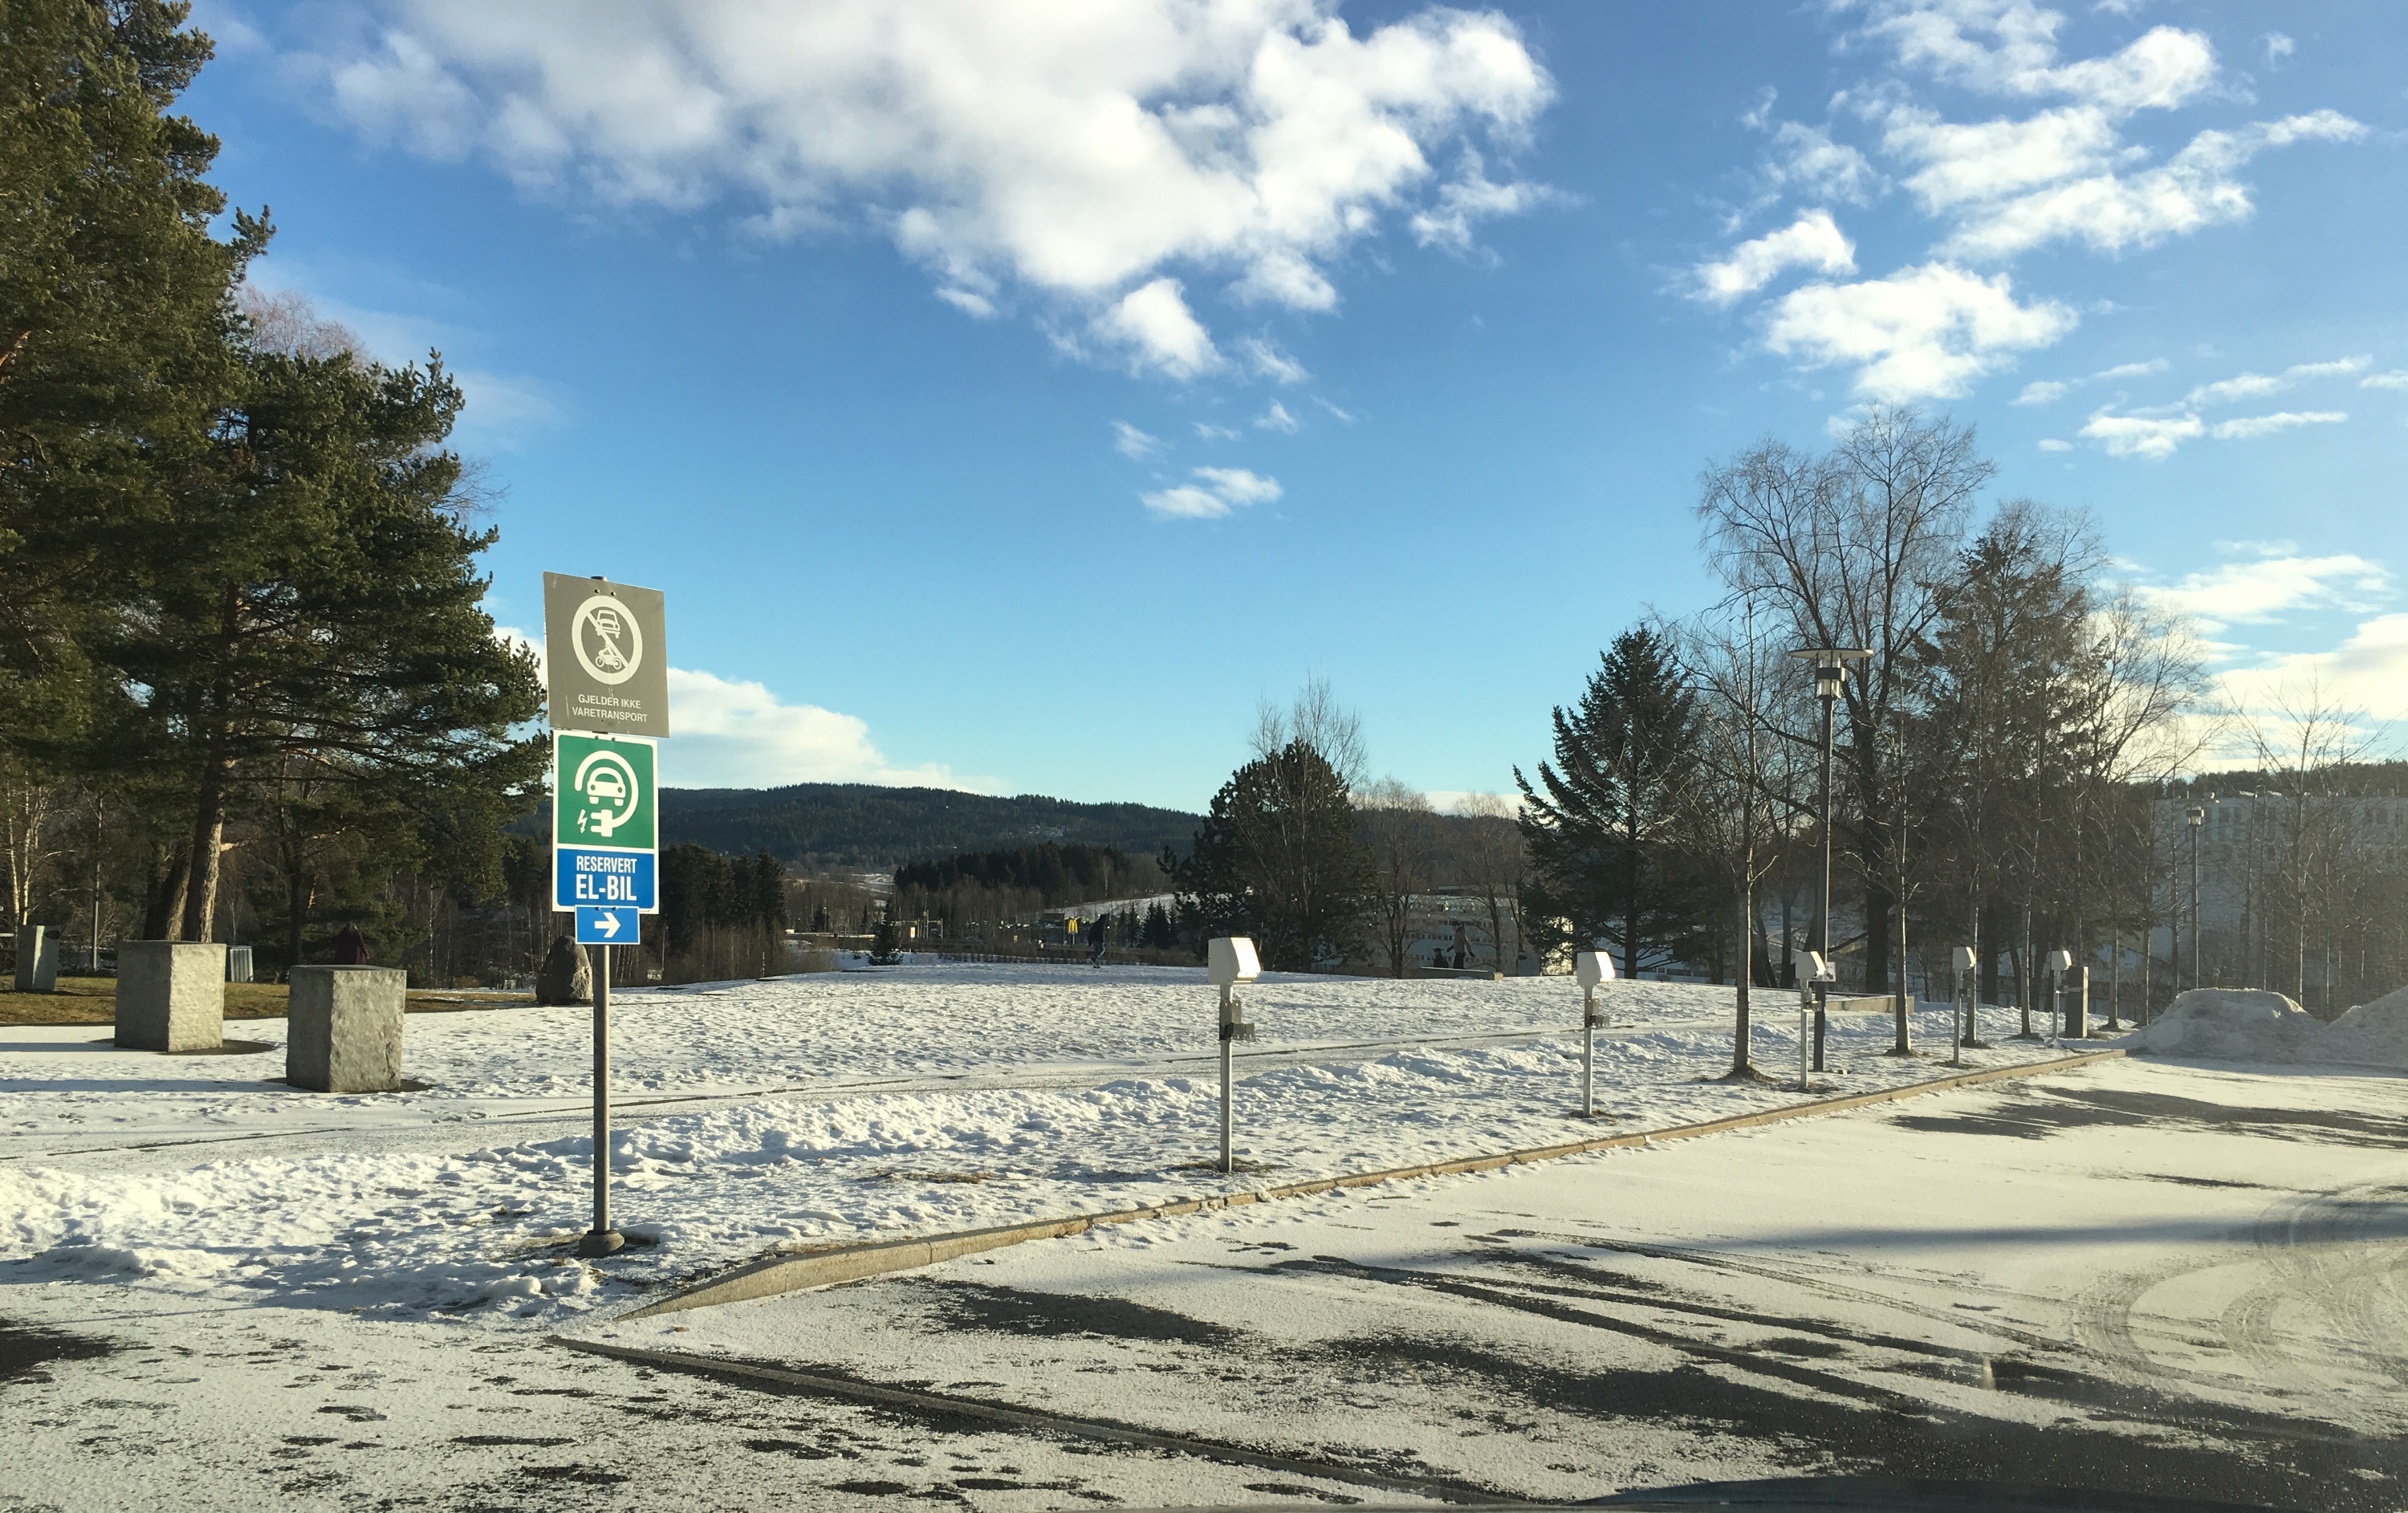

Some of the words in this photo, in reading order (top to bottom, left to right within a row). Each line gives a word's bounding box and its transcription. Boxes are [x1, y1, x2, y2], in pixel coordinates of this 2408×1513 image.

[578, 693, 619, 707] GJELDER
[620, 698, 641, 709] IKKE
[571, 706, 648, 722] VARETRANSPORT
[576, 855, 637, 873] RESERVERT
[576, 873, 637, 901] EL-BIL
